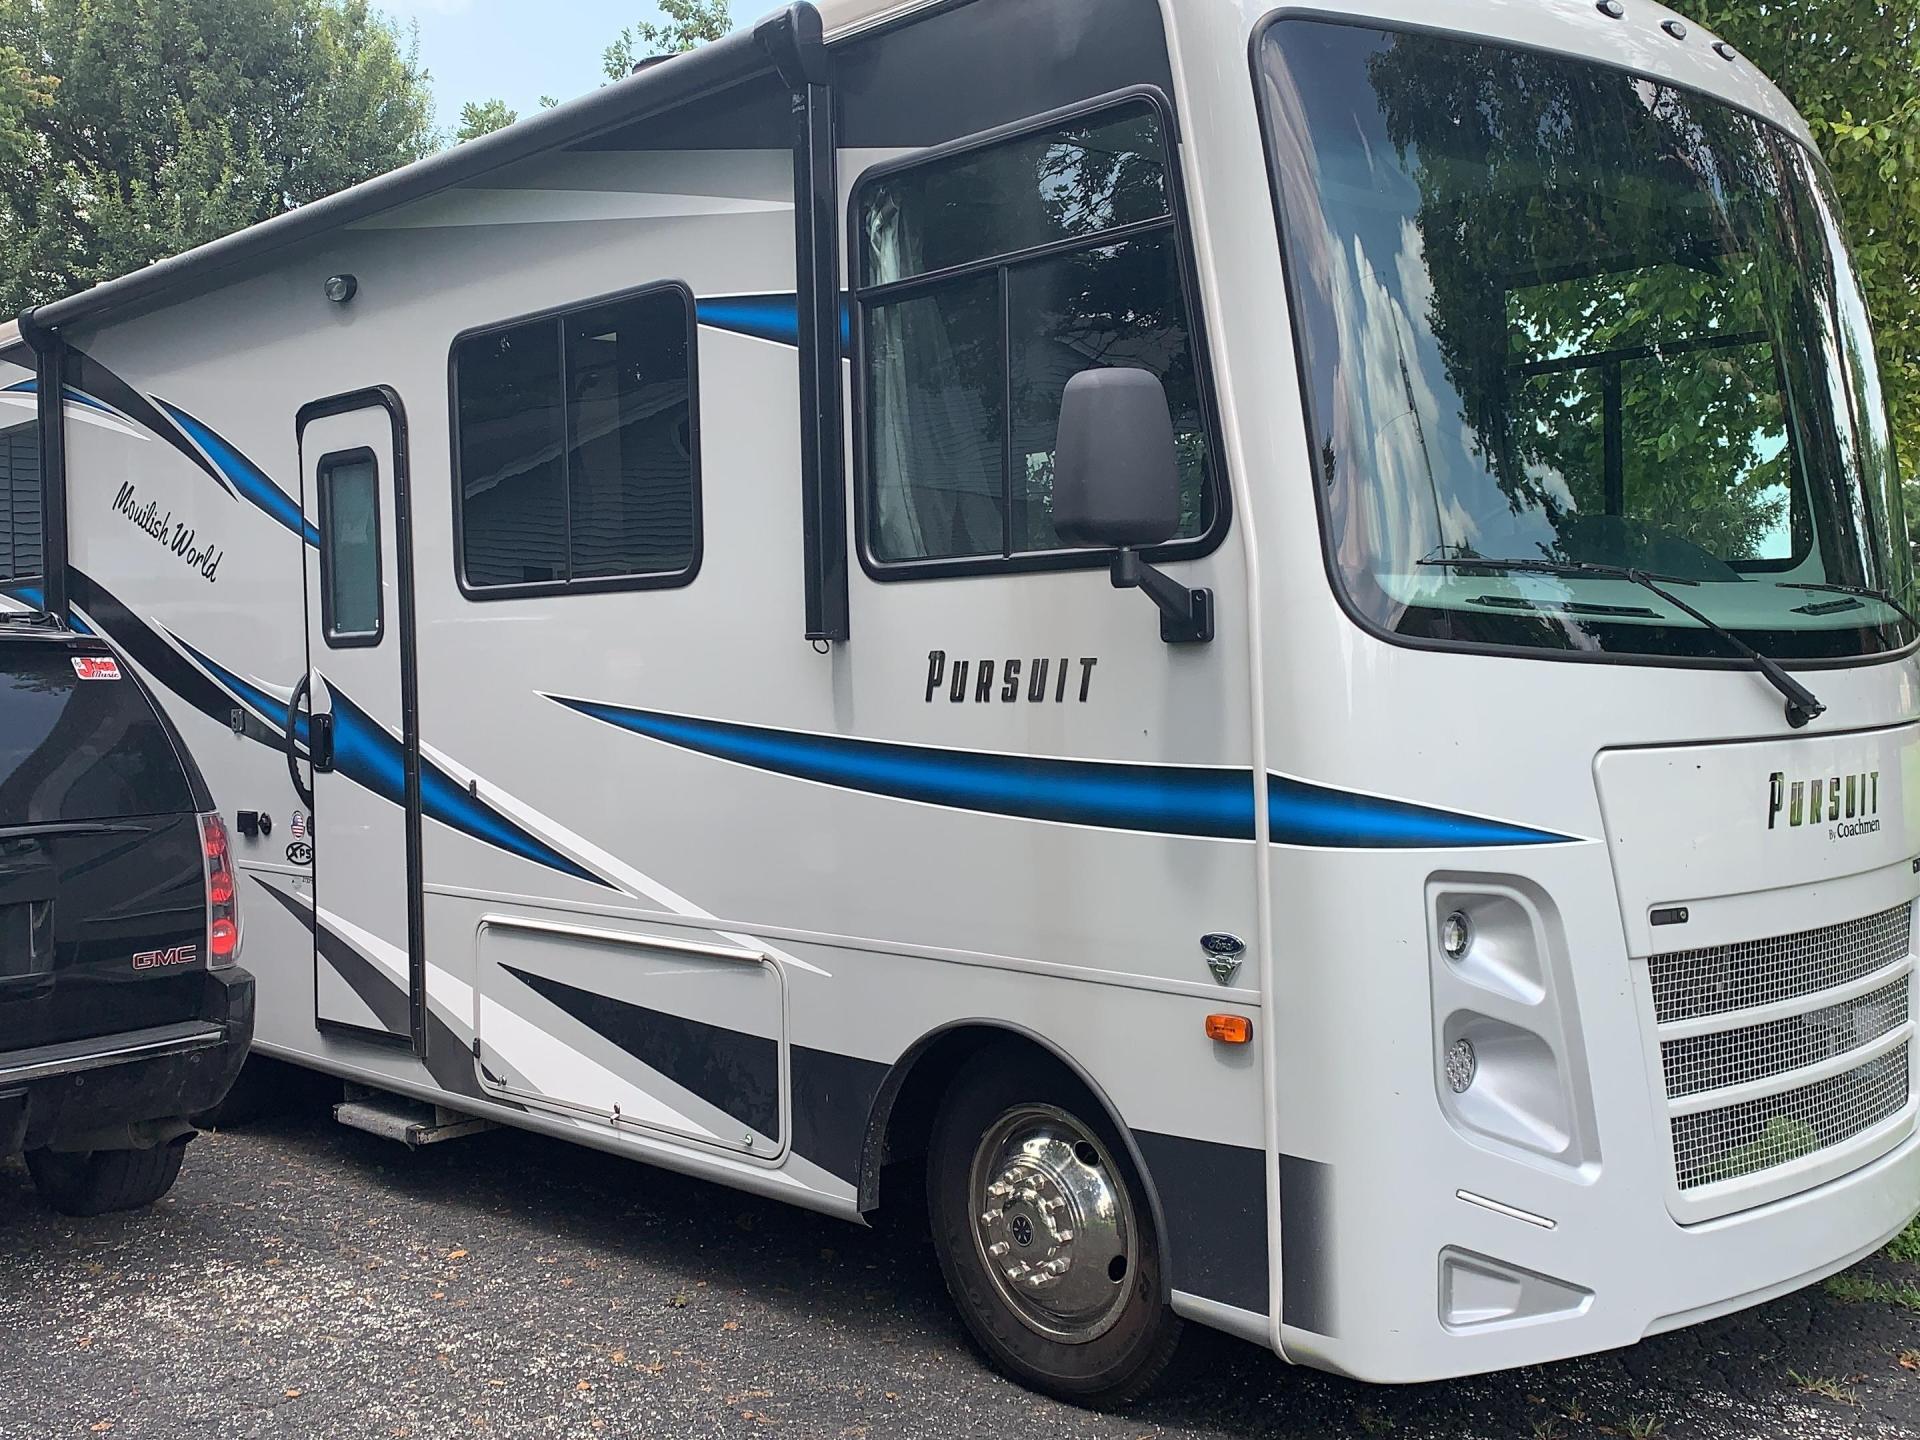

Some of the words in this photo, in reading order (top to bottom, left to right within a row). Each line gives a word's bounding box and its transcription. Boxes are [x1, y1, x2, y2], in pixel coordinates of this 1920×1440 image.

[171, 522, 223, 583] World
[925, 650, 1098, 703] PURSUIT
[1768, 771, 1879, 830] PURSUIT
[1837, 818, 1880, 839] Coachmen
[132, 944, 197, 970] GMC
